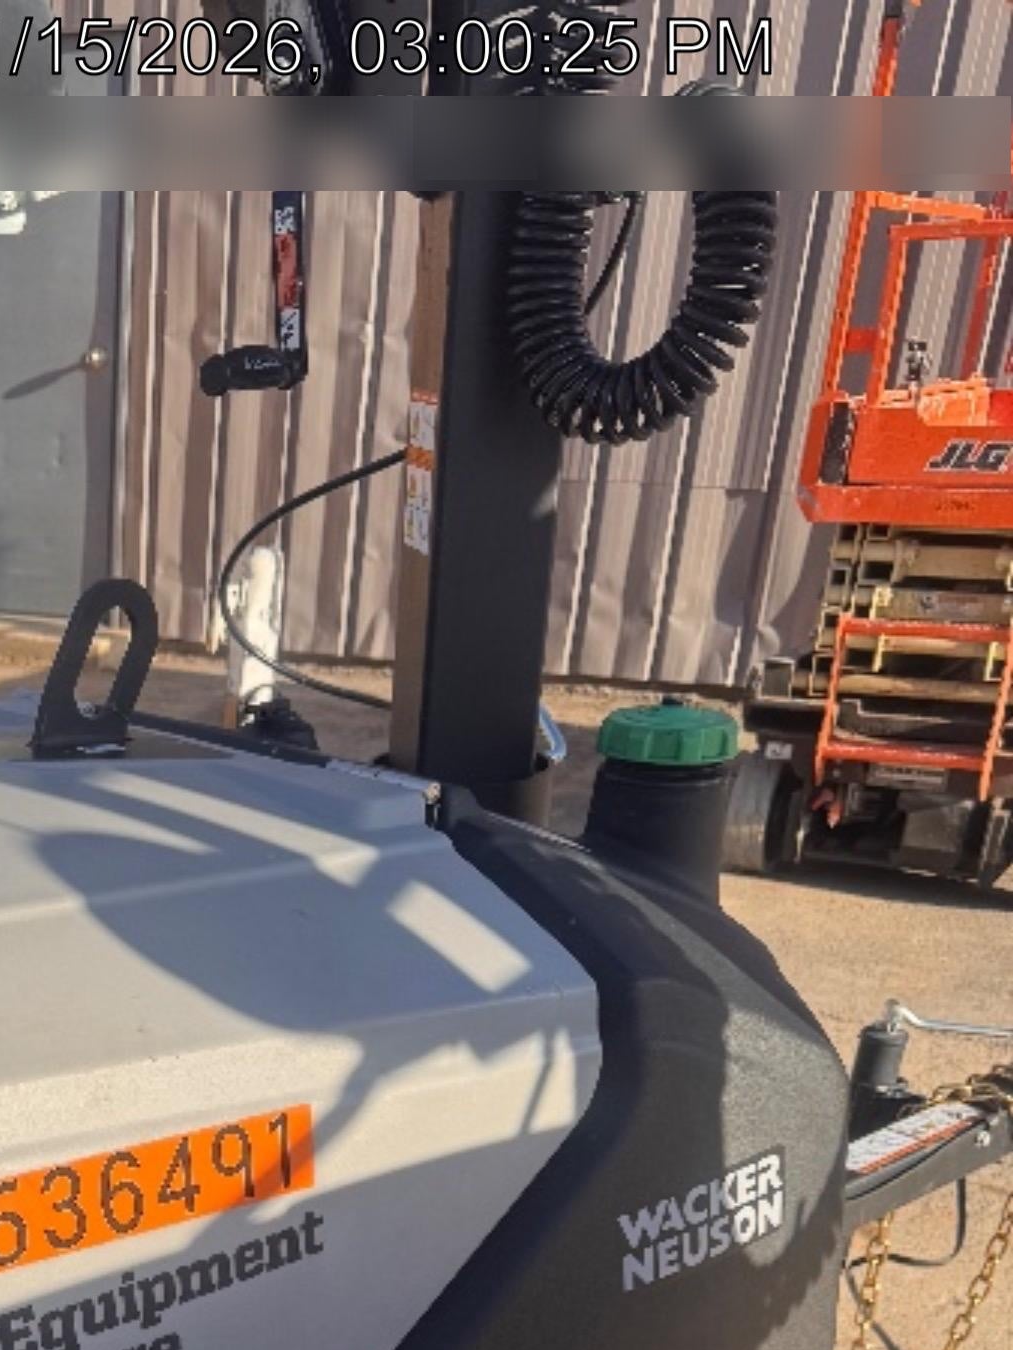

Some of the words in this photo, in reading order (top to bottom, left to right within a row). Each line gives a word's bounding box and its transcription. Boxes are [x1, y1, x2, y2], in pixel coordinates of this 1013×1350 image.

[923, 439, 1012, 473] JLG
[617, 1154, 784, 1248] WACKER
[622, 1190, 784, 1292] NEUSON
